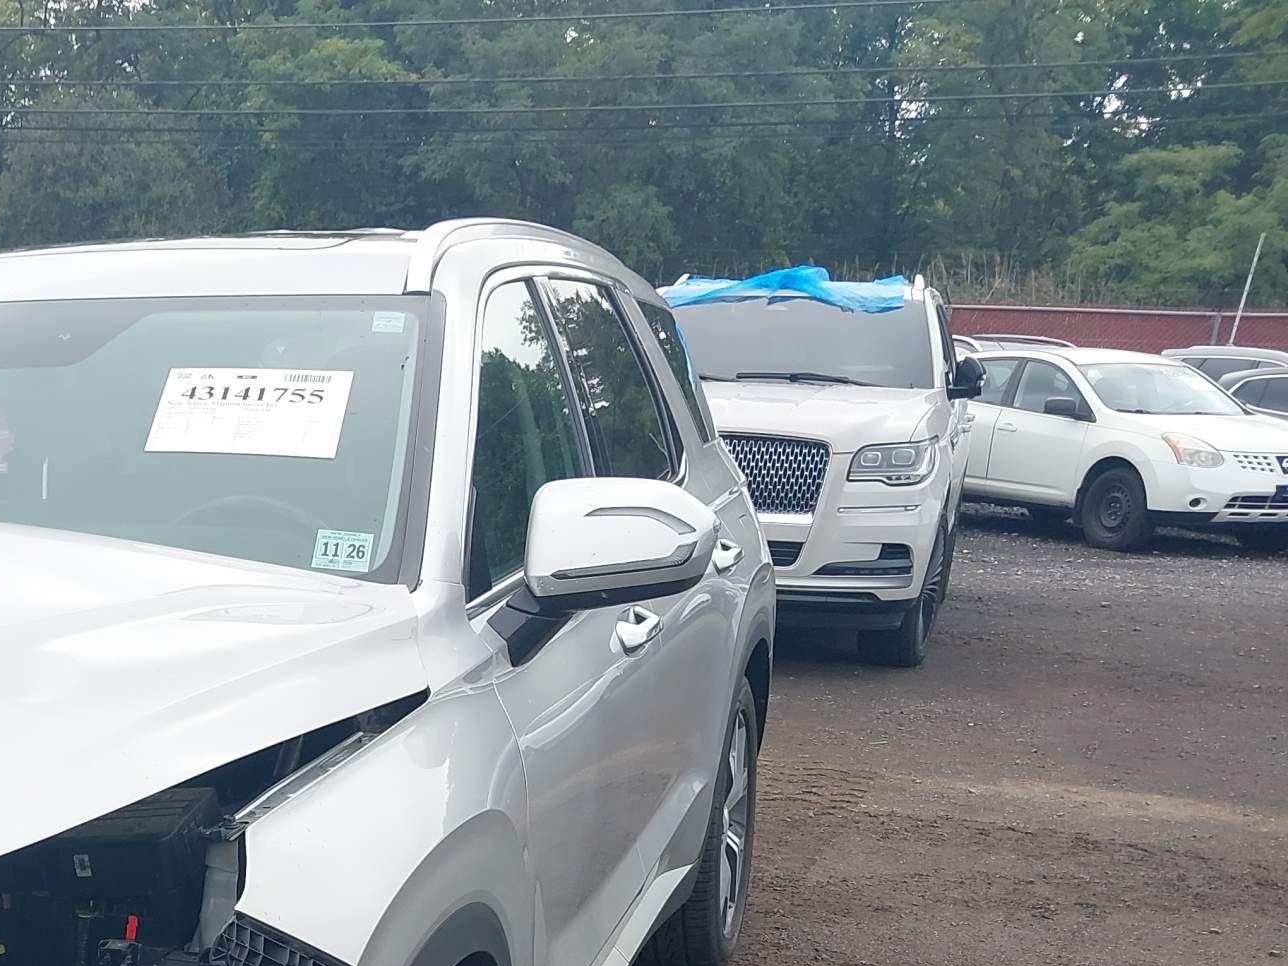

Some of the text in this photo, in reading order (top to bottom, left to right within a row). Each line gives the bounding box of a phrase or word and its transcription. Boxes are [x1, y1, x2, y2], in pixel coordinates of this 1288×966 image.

[180, 385, 326, 404] 43141755
[320, 541, 367, 560] 11 26
